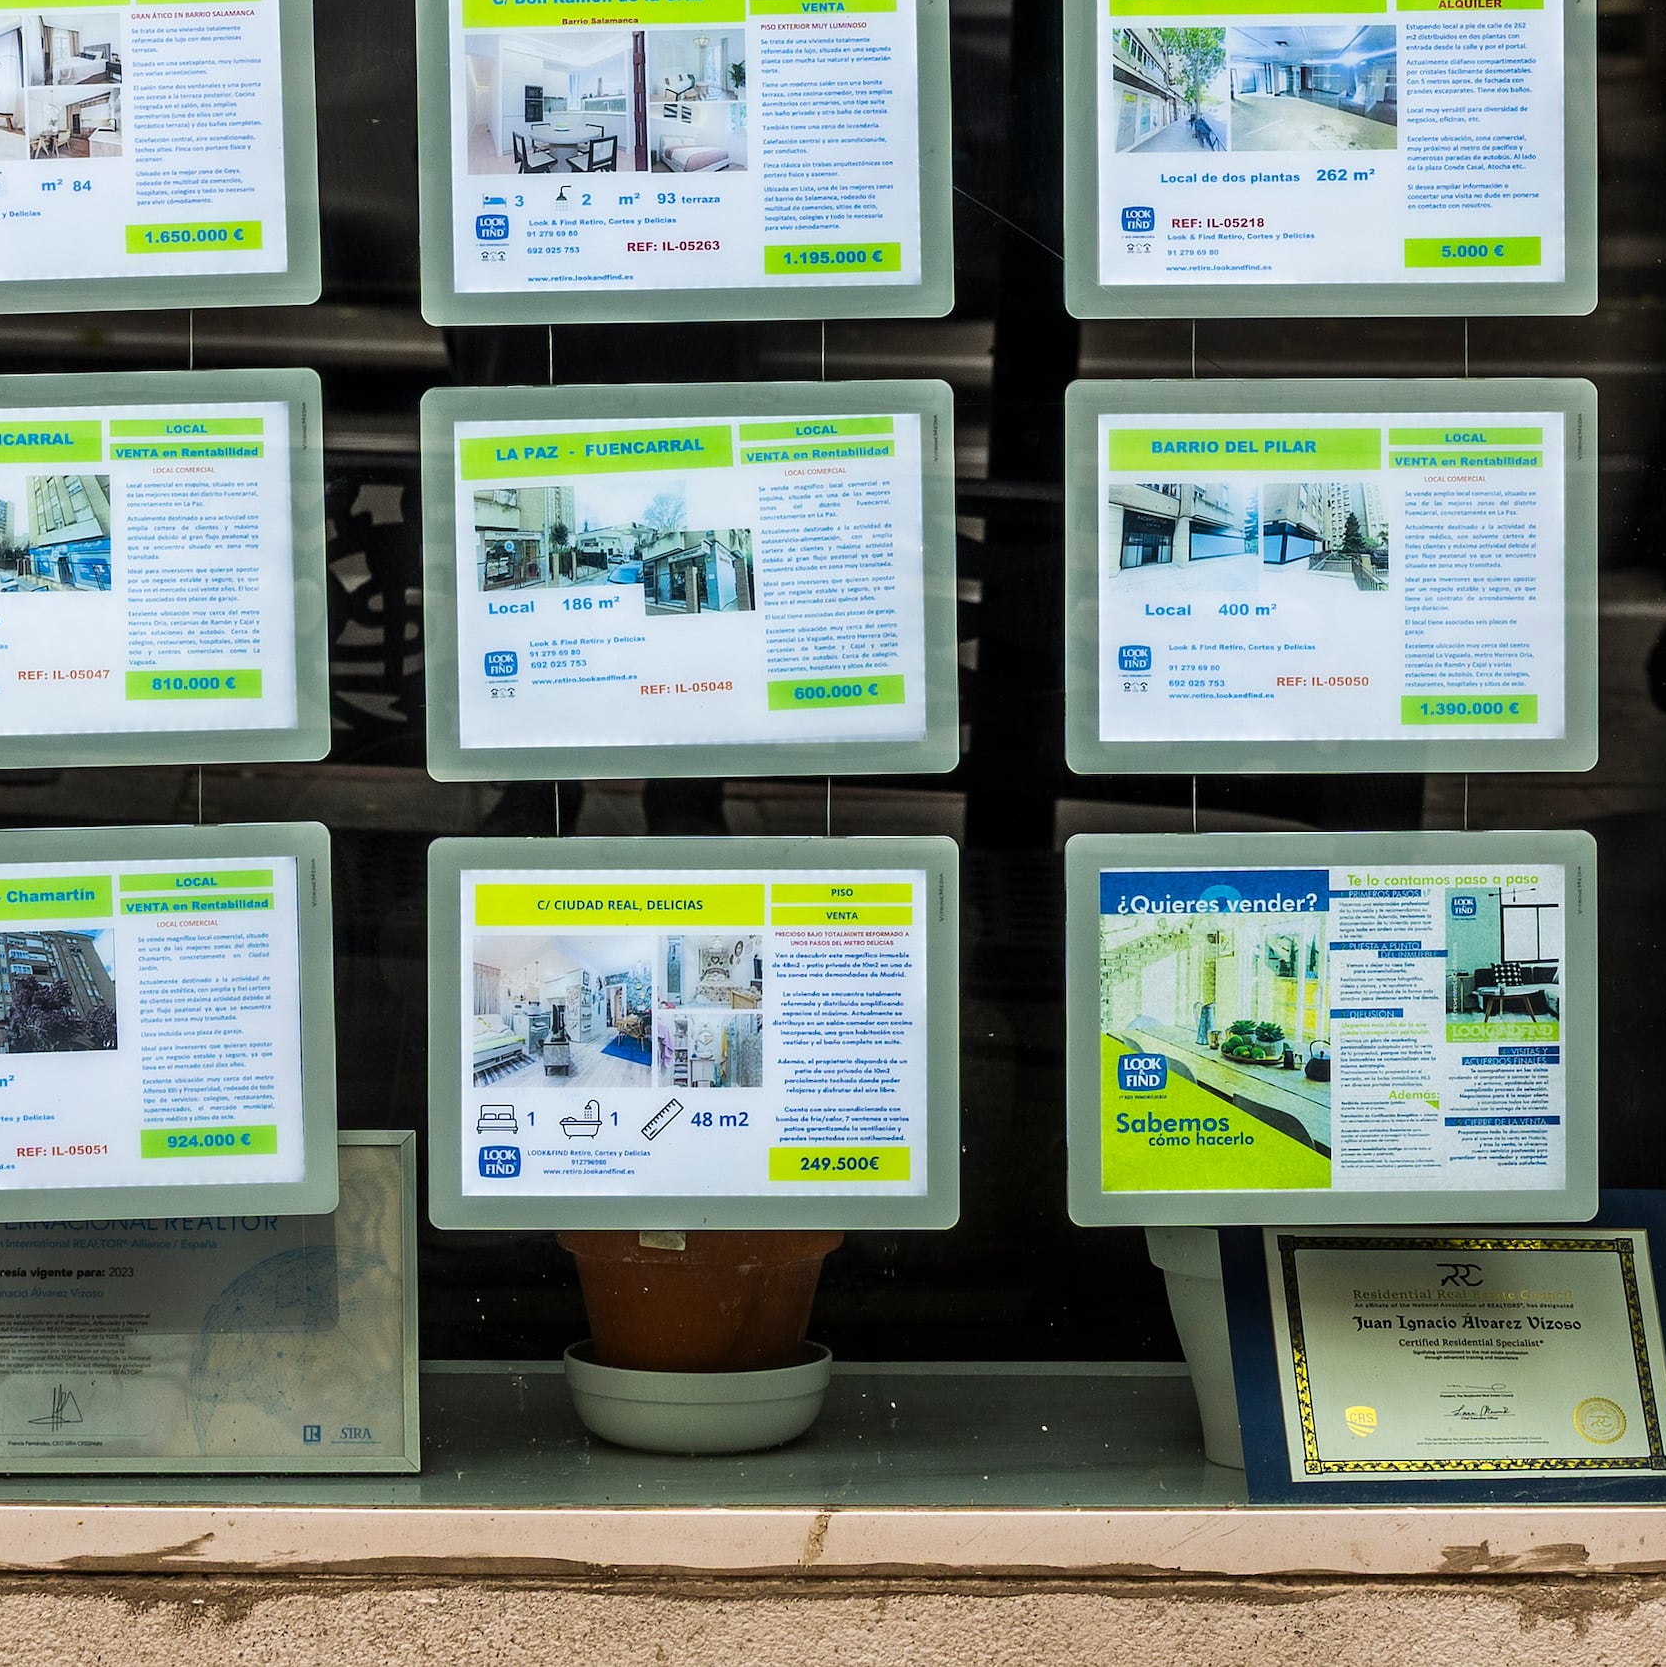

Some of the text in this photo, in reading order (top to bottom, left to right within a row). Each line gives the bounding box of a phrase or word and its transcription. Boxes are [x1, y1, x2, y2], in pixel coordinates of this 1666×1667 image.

[801, 2, 846, 13] VENTA
[561, 17, 639, 26] Barrio Salamanca
[1160, 172, 1301, 185] Local de dos plantas
[1171, 217, 1265, 229] REF: IL-05218
[144, 227, 244, 244] 1.650.000 €
[627, 240, 720, 253] REF: IL-05263
[1441, 244, 1505, 258] 5.000 €
[783, 249, 883, 265] 1.195.000 €
[495, 447, 519, 462] LA
[523, 445, 559, 460] PAZ
[585, 438, 705, 457] FUENCARRAL
[1151, 440, 1317, 454] BARRIO DEL PILAR
[17, 669, 111, 681] REF: IL-05047
[1276, 676, 1369, 687] REF: IL-05050
[151, 676, 236, 691] 810.000 €
[794, 683, 879, 701] 600.000 €
[1420, 701, 1520, 716] 1.390.000 €
[1347, 874, 1538, 888] Te lo contamos paso a paso
[6, 887, 96, 904] Chamartín
[830, 888, 854, 897] PISO
[536, 899, 703, 912] C/ CIUDAD REAL, DELICIAS
[1117, 893, 1317, 915] ¿Quieres vender?
[825, 911, 859, 920] VENTA
[1124, 1059, 1161, 1071] LOOK
[1125, 1072, 1160, 1088] FIND
[1117, 1113, 1229, 1134] Sabemos
[167, 1132, 251, 1149] 924.000 €
[1148, 1131, 1254, 1146] cómo hacerlo
[16, 1144, 108, 1158] REF: IL-05051
[800, 1156, 880, 1171] 249.500€
[29, 1266, 74, 1280] vigente
[76, 1269, 106, 1281] para:
[108, 1266, 135, 1278] 2023
[1351, 1312, 1582, 1332] Juan Ignacio Álvarez Vizoso
[1398, 1337, 1440, 1347] Certified
[1442, 1337, 1494, 1347] Residential
